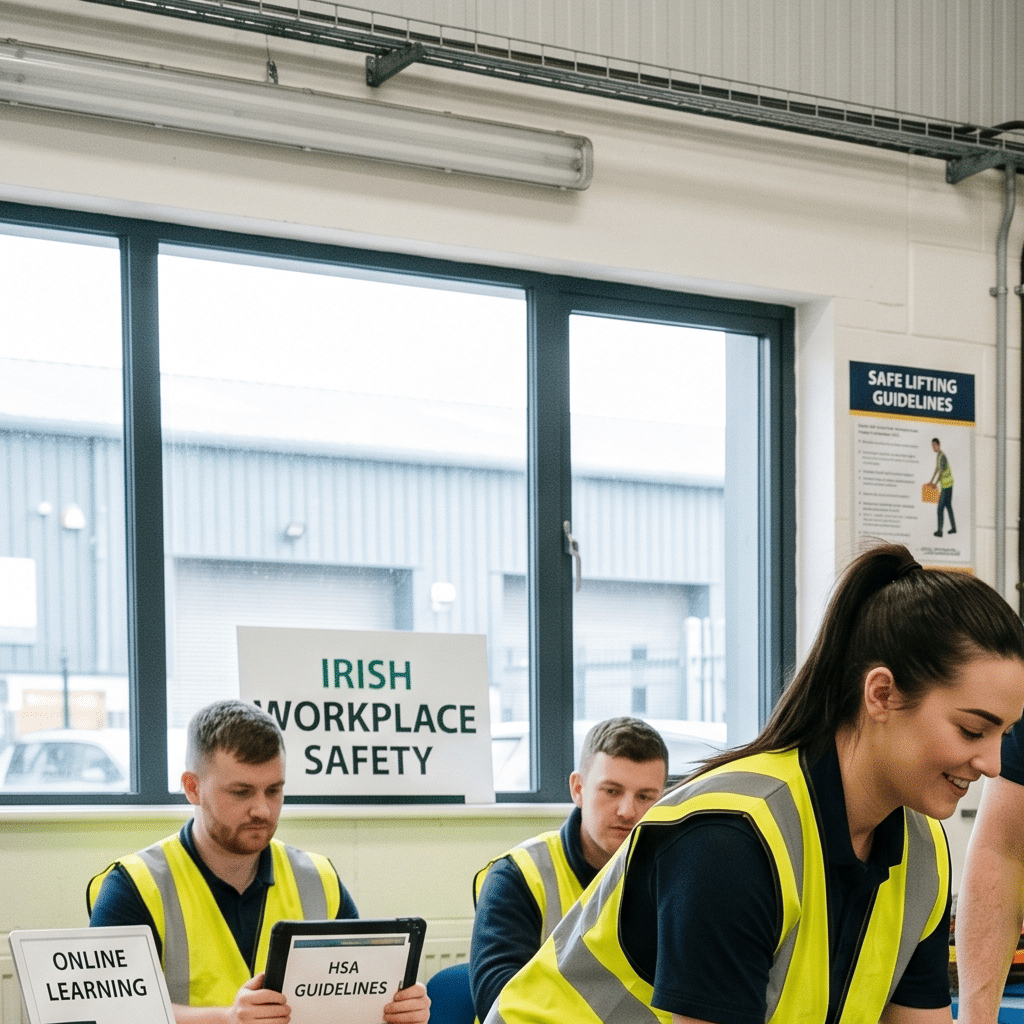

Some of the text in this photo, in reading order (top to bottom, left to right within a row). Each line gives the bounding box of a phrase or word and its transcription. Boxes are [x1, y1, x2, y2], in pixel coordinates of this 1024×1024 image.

[868, 370, 957, 394] SAFE LIFTING
[872, 390, 953, 412] GUIDELINES
[322, 658, 411, 690] IRISH
[253, 700, 477, 734] WORKPLACE
[304, 744, 434, 775] SAFETY
[52, 949, 128, 971] ONLINE
[328, 961, 360, 975] HSA
[46, 978, 148, 1002] LEARNING
[294, 980, 388, 998] GUIDELINES
